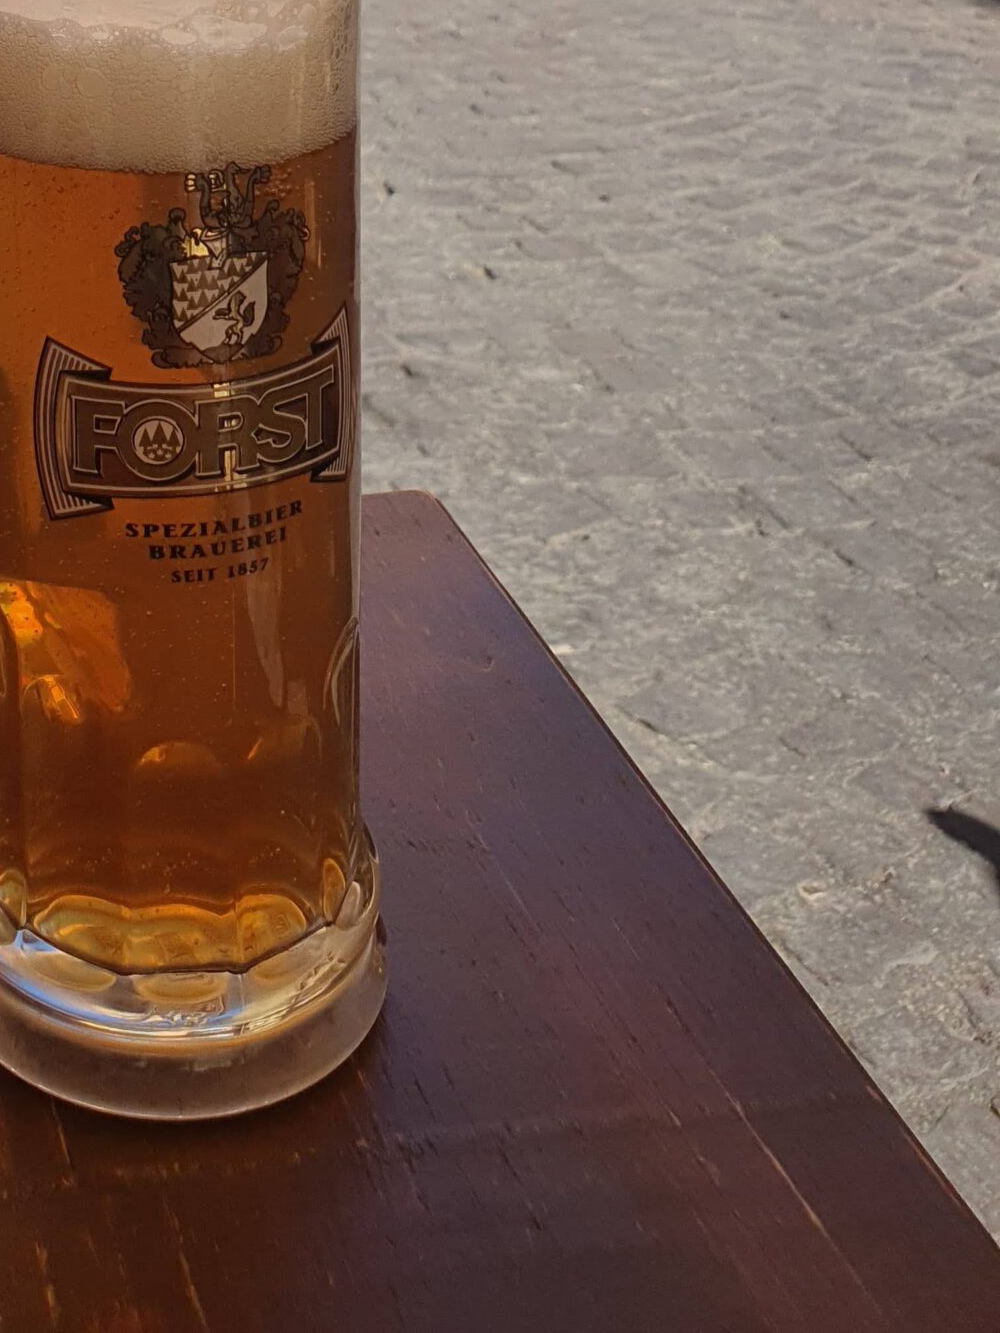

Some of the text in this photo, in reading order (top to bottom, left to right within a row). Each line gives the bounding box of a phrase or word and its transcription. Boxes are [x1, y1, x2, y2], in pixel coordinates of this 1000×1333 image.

[70, 364, 335, 482] FORST
[125, 500, 303, 539] SPEZIALBIER
[149, 527, 287, 560] BRAUEREI
[171, 557, 269, 583] SEIT 1857
